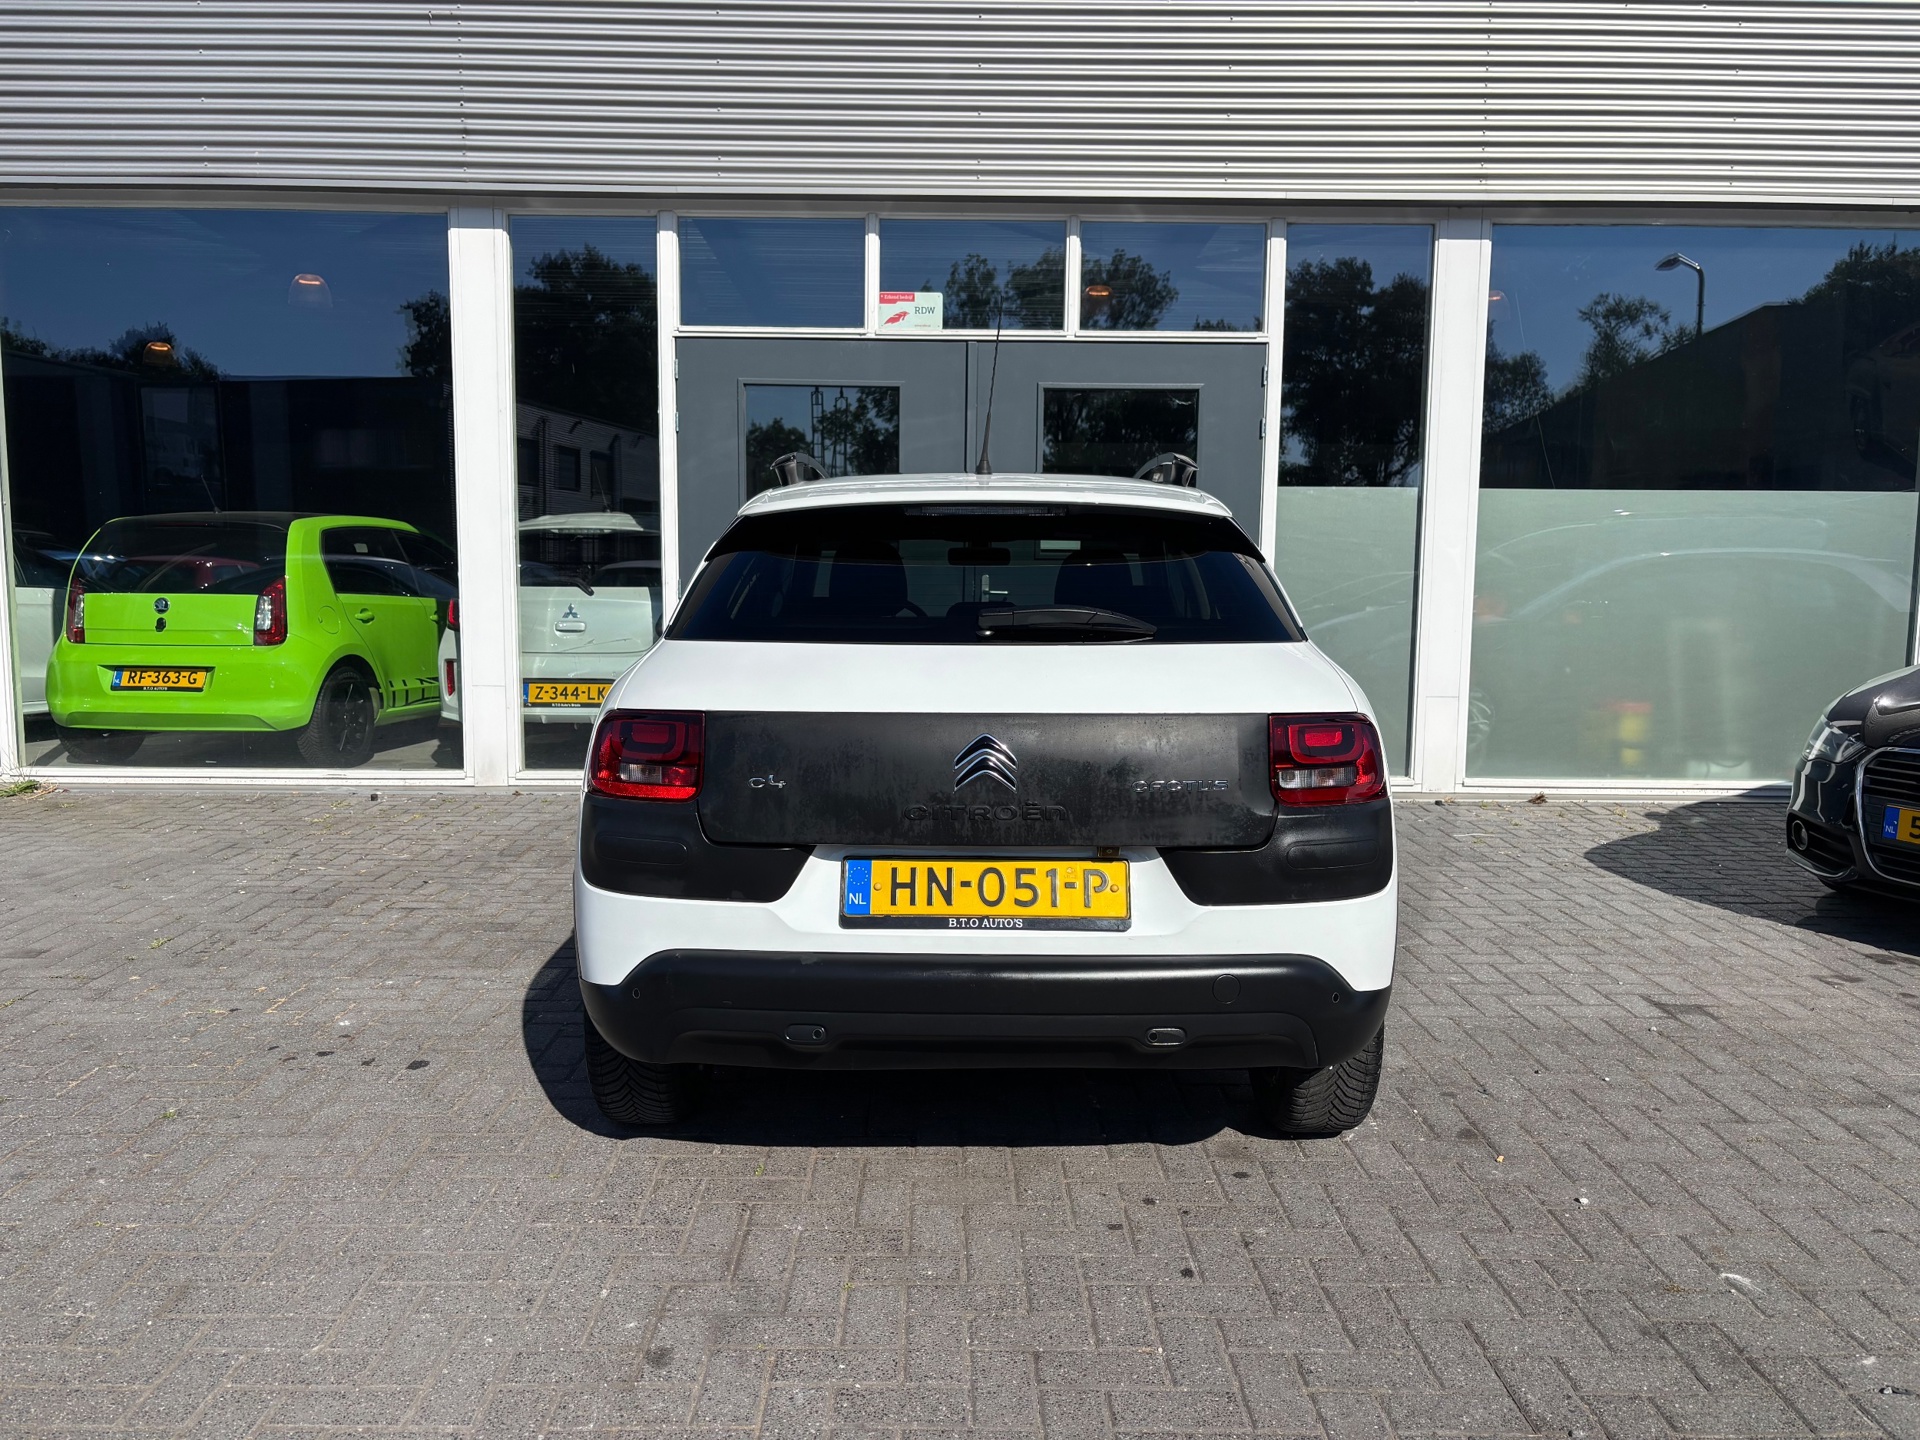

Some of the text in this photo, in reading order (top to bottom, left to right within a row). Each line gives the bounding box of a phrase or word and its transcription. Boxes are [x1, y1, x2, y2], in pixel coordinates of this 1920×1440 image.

[914, 306, 936, 315] RDW
[127, 670, 198, 685] RF-363-G
[534, 686, 606, 701] Z-344-LK
[748, 774, 787, 789] C4
[1131, 779, 1229, 792] CACTUS
[1885, 825, 1896, 834] NL
[890, 866, 1110, 909] HN-051-P
[848, 892, 867, 905] NL
[948, 918, 1024, 928] B.T.O AUTO'S
